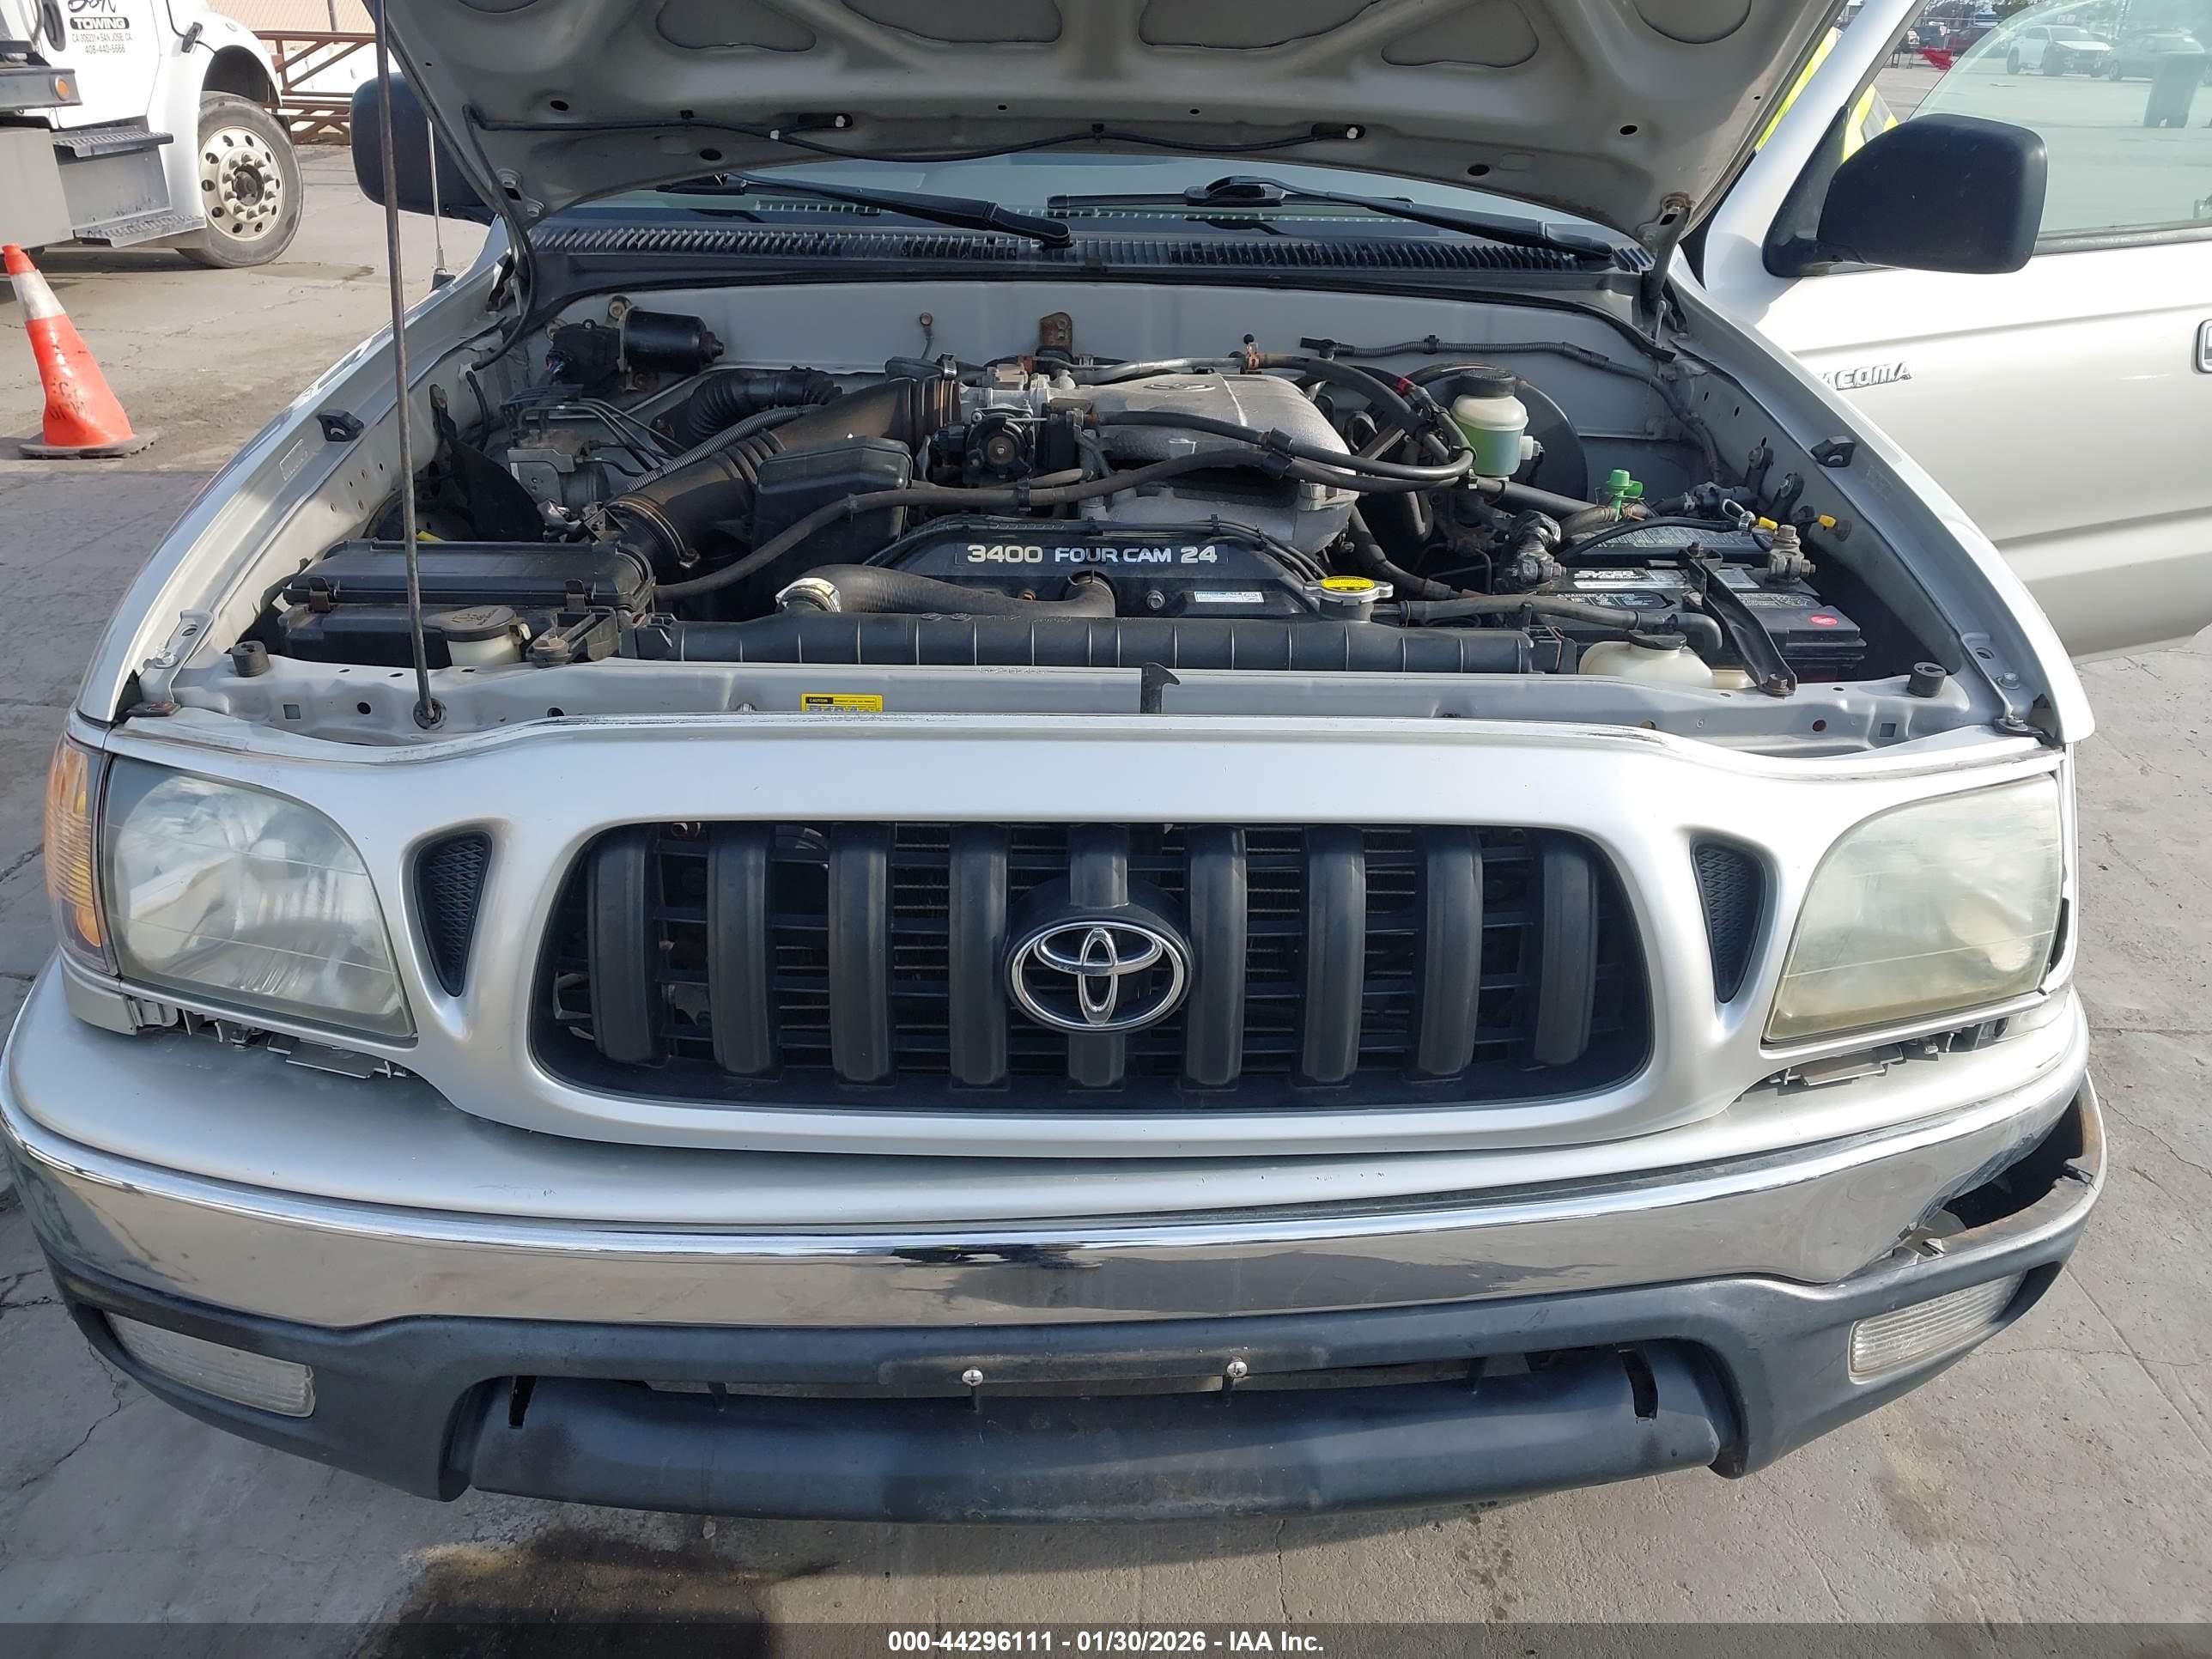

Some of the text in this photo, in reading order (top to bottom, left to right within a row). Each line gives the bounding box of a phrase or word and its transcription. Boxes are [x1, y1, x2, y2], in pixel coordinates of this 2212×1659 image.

[74, 18, 126, 29] TOWING
[1820, 361, 1912, 391] ACOMA
[967, 545, 1218, 563] 3400 FOUR CAM 24
